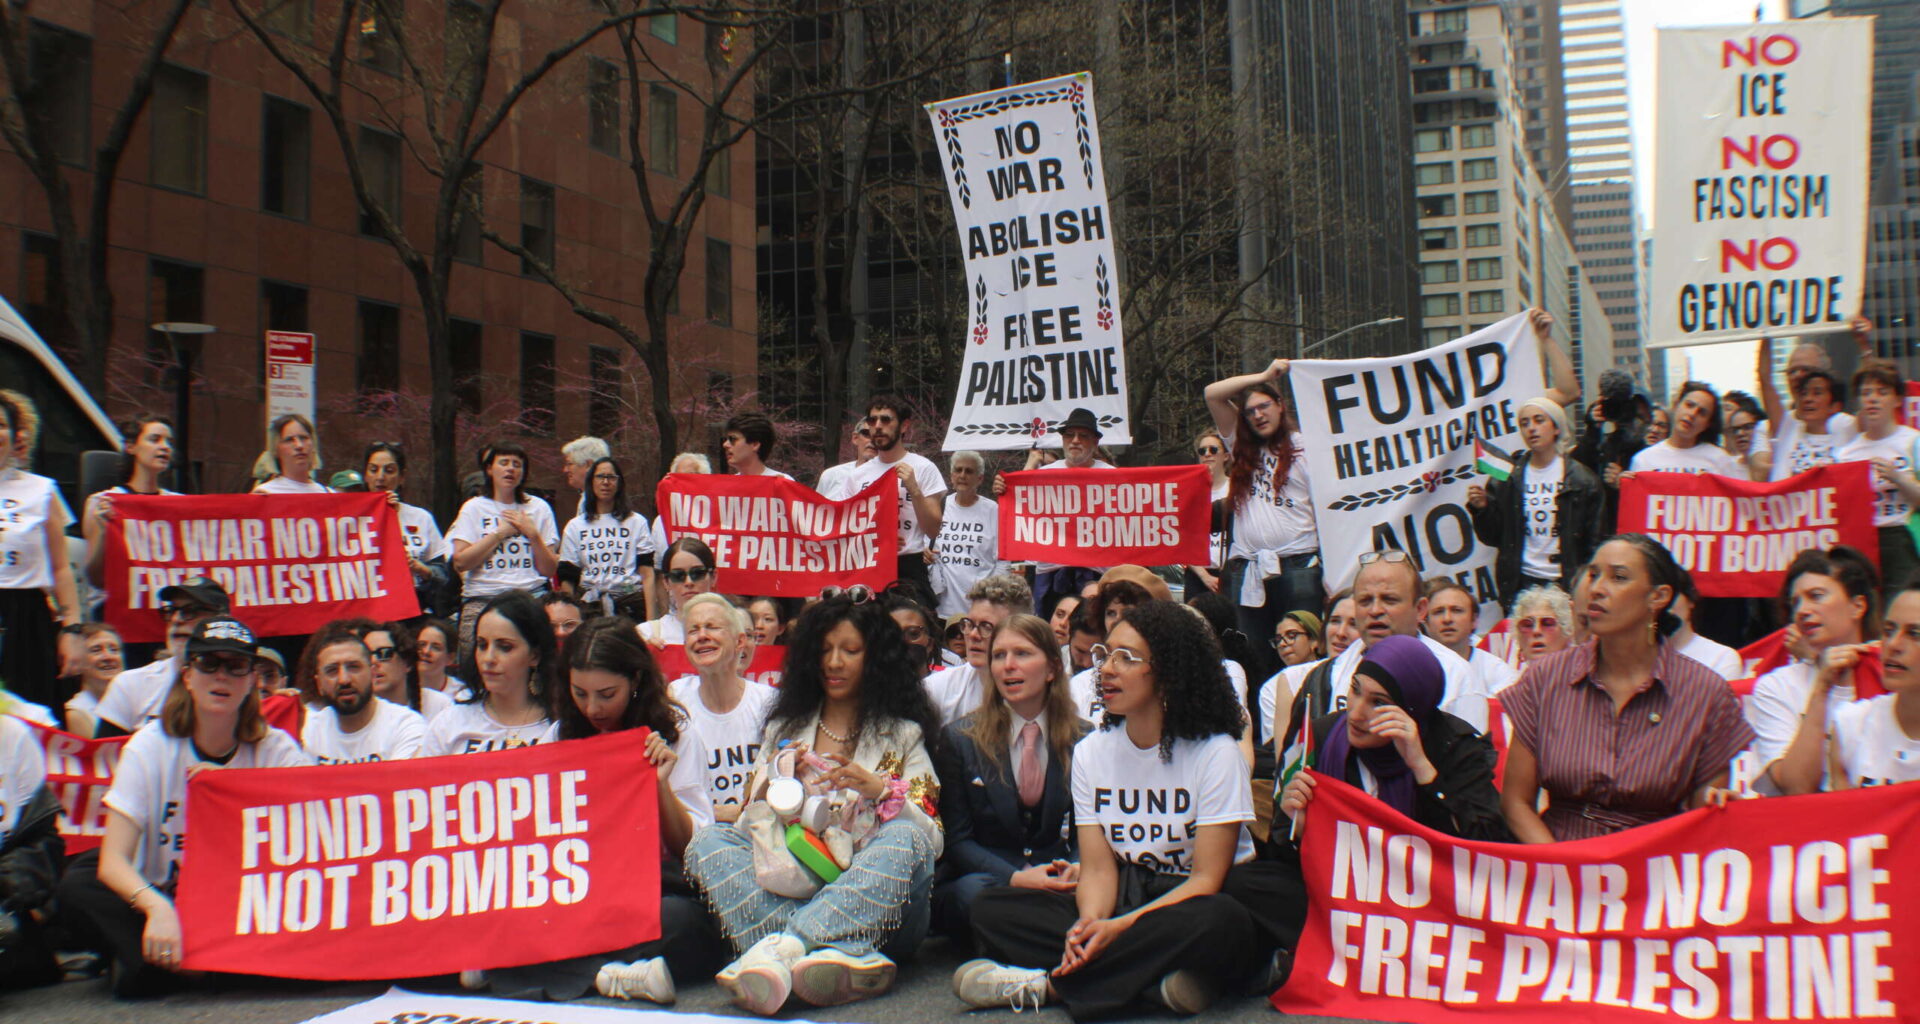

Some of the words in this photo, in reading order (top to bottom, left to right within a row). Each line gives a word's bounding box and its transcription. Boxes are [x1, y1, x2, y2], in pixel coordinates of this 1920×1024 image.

[1721, 34, 1799, 68] NO
[1739, 72, 1786, 117] ICE
[994, 121, 1040, 159] NO
[1721, 134, 1799, 170] NO
[987, 158, 1064, 201] WAR
[1694, 174, 1830, 222] FASCISM
[969, 206, 1105, 260] ABOLISH
[1720, 236, 1799, 273] NO
[1012, 253, 1057, 291] ICE
[1680, 275, 1843, 333] GENOCIDE
[1004, 306, 1083, 350] FREE
[965, 347, 1119, 406] PALESTINE
[1322, 342, 1507, 434] FUND
[1333, 399, 1518, 480] HEALTHCARE
[670, 492, 711, 529] NO
[718, 495, 789, 532] WAR
[792, 500, 835, 537] NO
[839, 495, 880, 535] ICE
[1015, 484, 1081, 514] FUND
[1087, 482, 1179, 514] PEOPLE
[1646, 494, 1733, 532] FUND
[1735, 487, 1839, 532] PEOPLE
[123, 518, 175, 563] NO
[180, 517, 267, 563] WAR
[271, 515, 323, 559] NO
[325, 515, 380, 557] ICE
[580, 528, 630, 540] FUND
[941, 544, 974, 555] NOT
[1014, 516, 1068, 547] NOT
[1077, 515, 1179, 547] BOMBS
[485, 558, 532, 569] BOMB
[589, 552, 622, 564] NOT
[738, 533, 879, 573] PALESTINE
[211, 559, 387, 606] PALESTINE
[708, 744, 761, 769] UND
[242, 794, 382, 869] FUND
[394, 770, 588, 852] PEOPLE
[1095, 787, 1190, 814] FUND
[1100, 819, 1197, 842] EOPLE
[235, 864, 357, 935] NOT
[370, 838, 590, 926] BOMBS
[1331, 820, 1433, 908] NO
[1452, 845, 1628, 933] WAR
[1644, 847, 1752, 929] NO
[1768, 833, 1892, 925] ICE
[1327, 909, 1486, 1005] FREE
[1496, 930, 1896, 1021] PALESTINE
